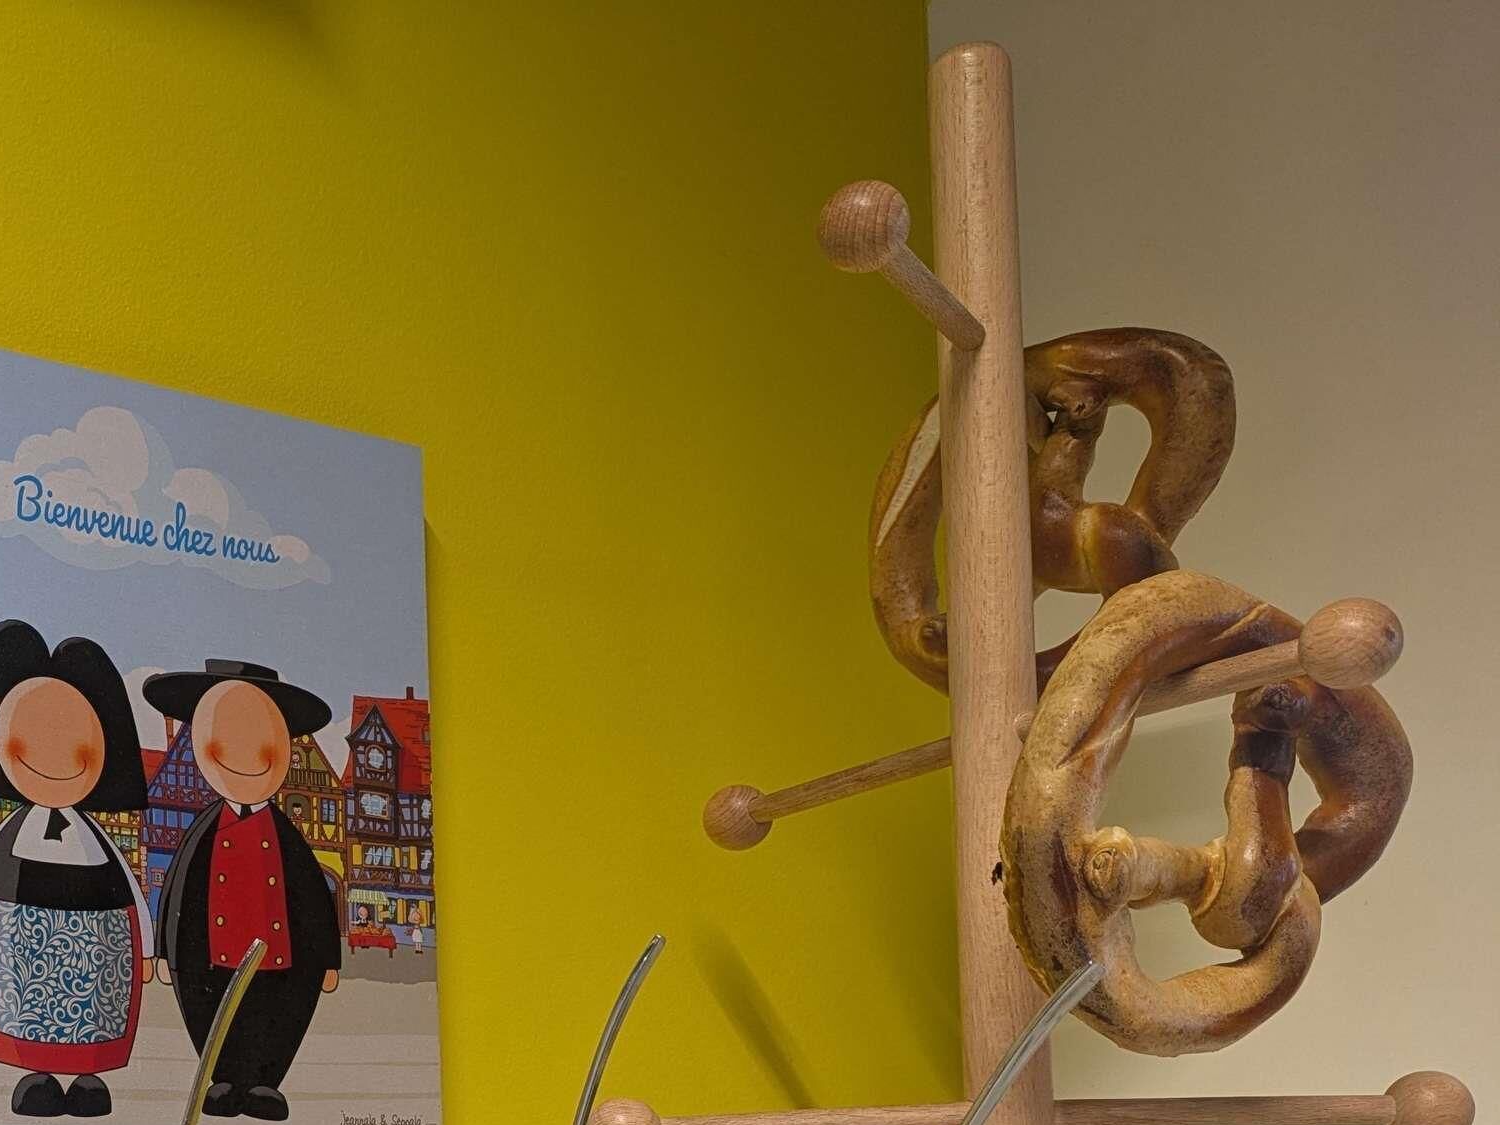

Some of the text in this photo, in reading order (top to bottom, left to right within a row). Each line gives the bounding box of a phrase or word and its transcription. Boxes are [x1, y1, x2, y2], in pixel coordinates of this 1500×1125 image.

[13, 474, 280, 563] Bienvenue chez nous
